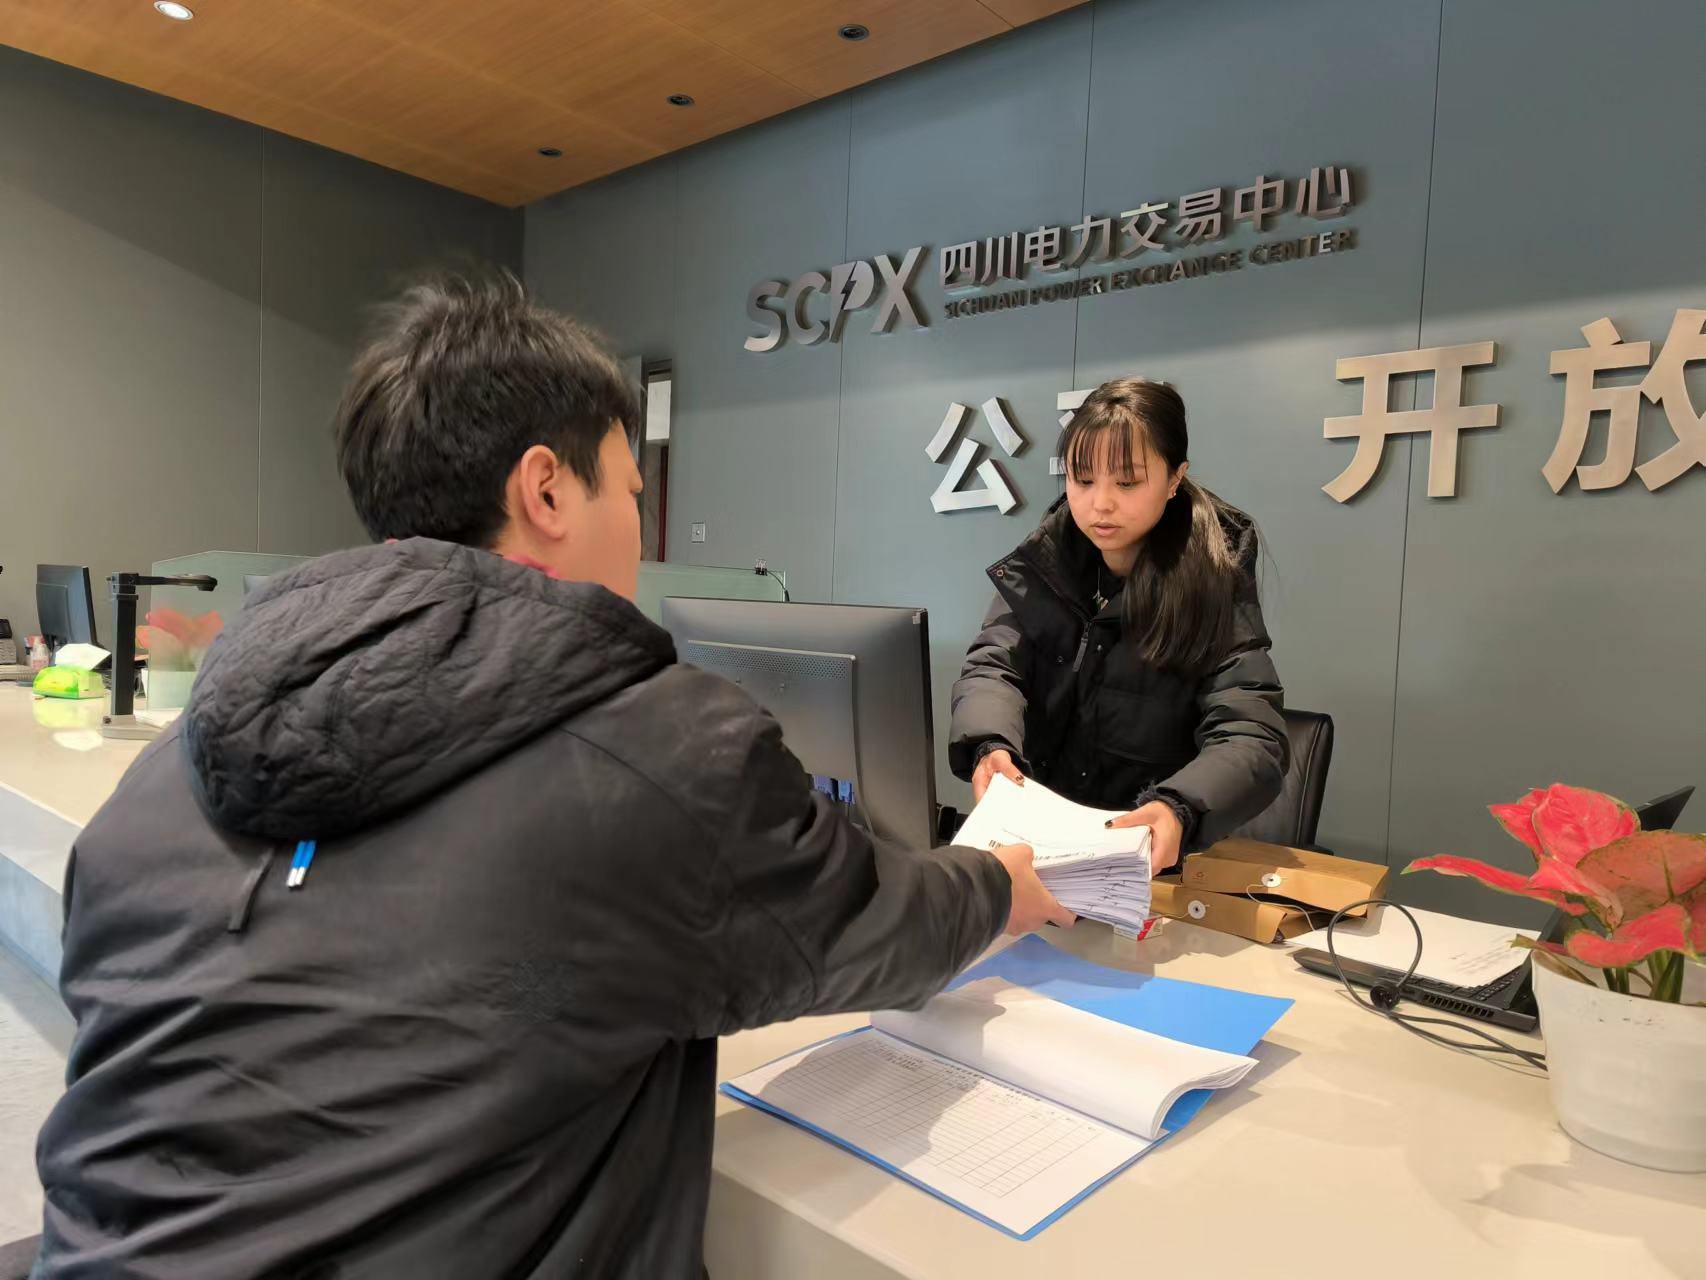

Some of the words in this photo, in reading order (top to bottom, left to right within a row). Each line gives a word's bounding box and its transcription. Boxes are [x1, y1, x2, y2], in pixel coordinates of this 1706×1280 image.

[940, 166, 1350, 286] 四川电力交易中心
[944, 289, 1027, 319] SICHUAN
[1030, 274, 1106, 305] POWER
[1111, 249, 1243, 291] EXCHANGE
[1249, 229, 1354, 265] CENTER
[744, 246, 925, 352] SCPX
